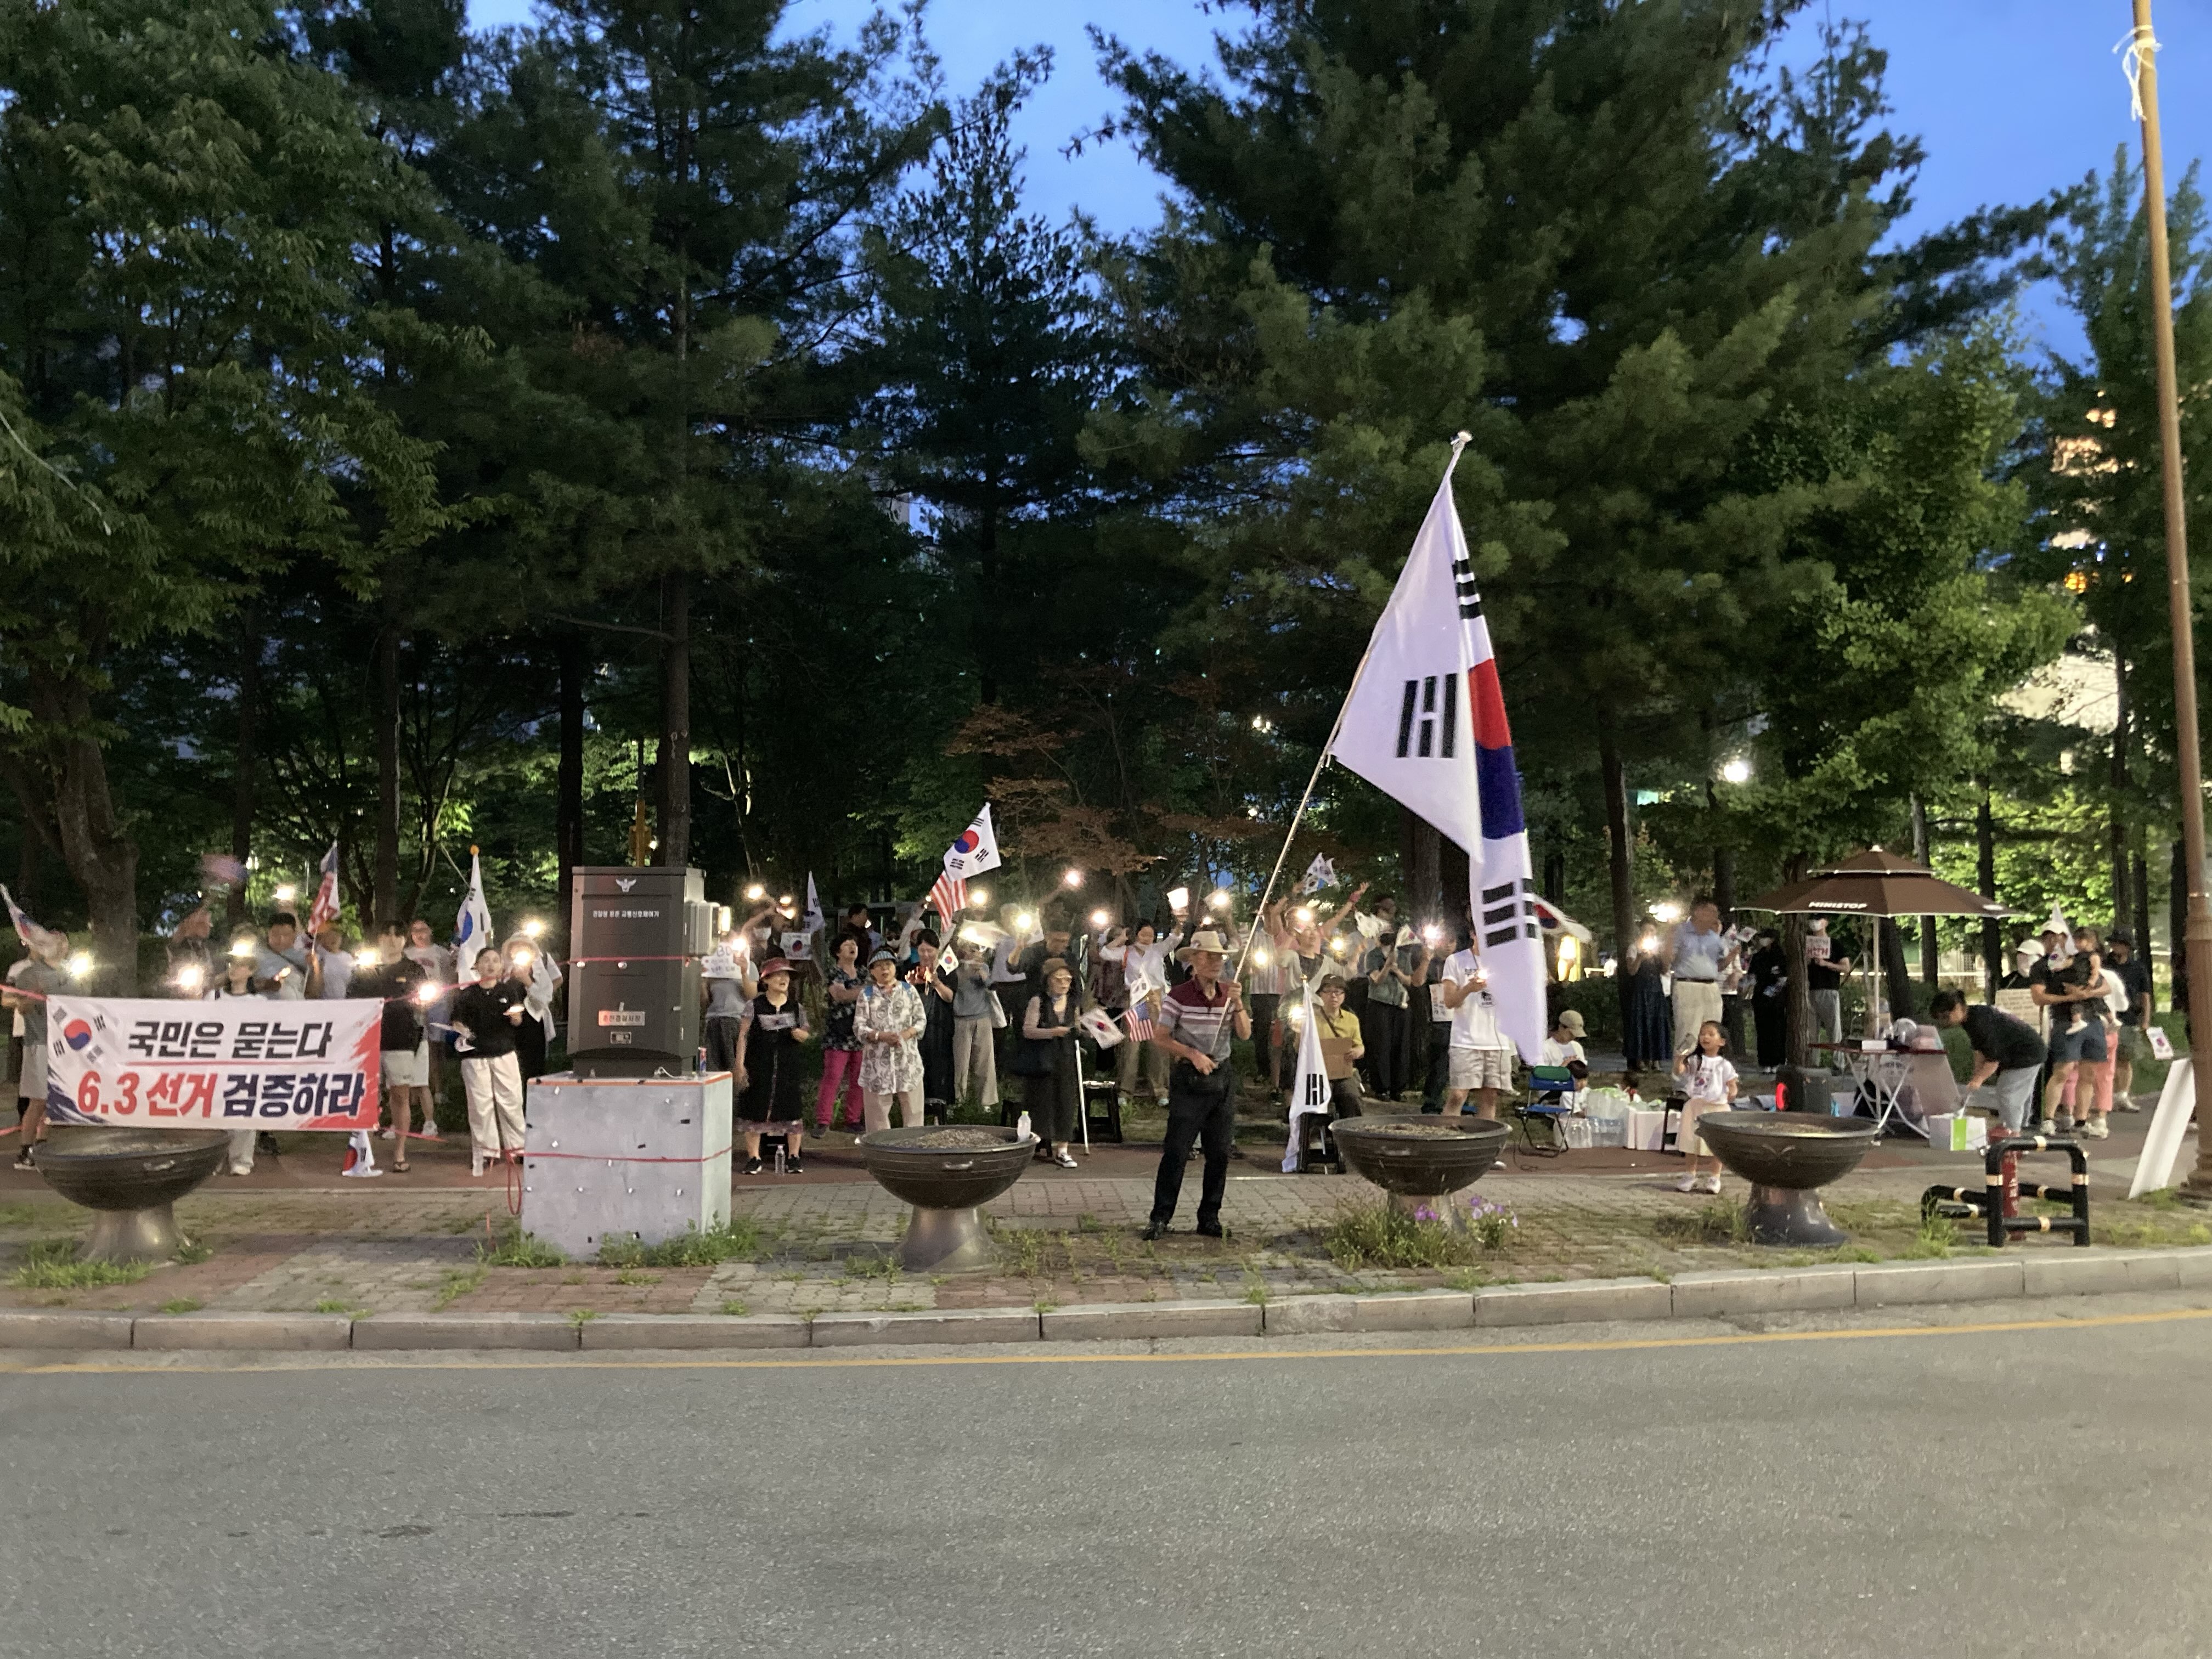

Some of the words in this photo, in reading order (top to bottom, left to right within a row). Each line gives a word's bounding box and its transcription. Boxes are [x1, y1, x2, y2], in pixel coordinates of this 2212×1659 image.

[128, 1020, 224, 1058] 국민은
[231, 1022, 333, 1059] 묻는다
[77, 1070, 140, 1115] 6.3
[146, 1073, 218, 1118] 선거
[223, 1073, 365, 1118] 검증하라
